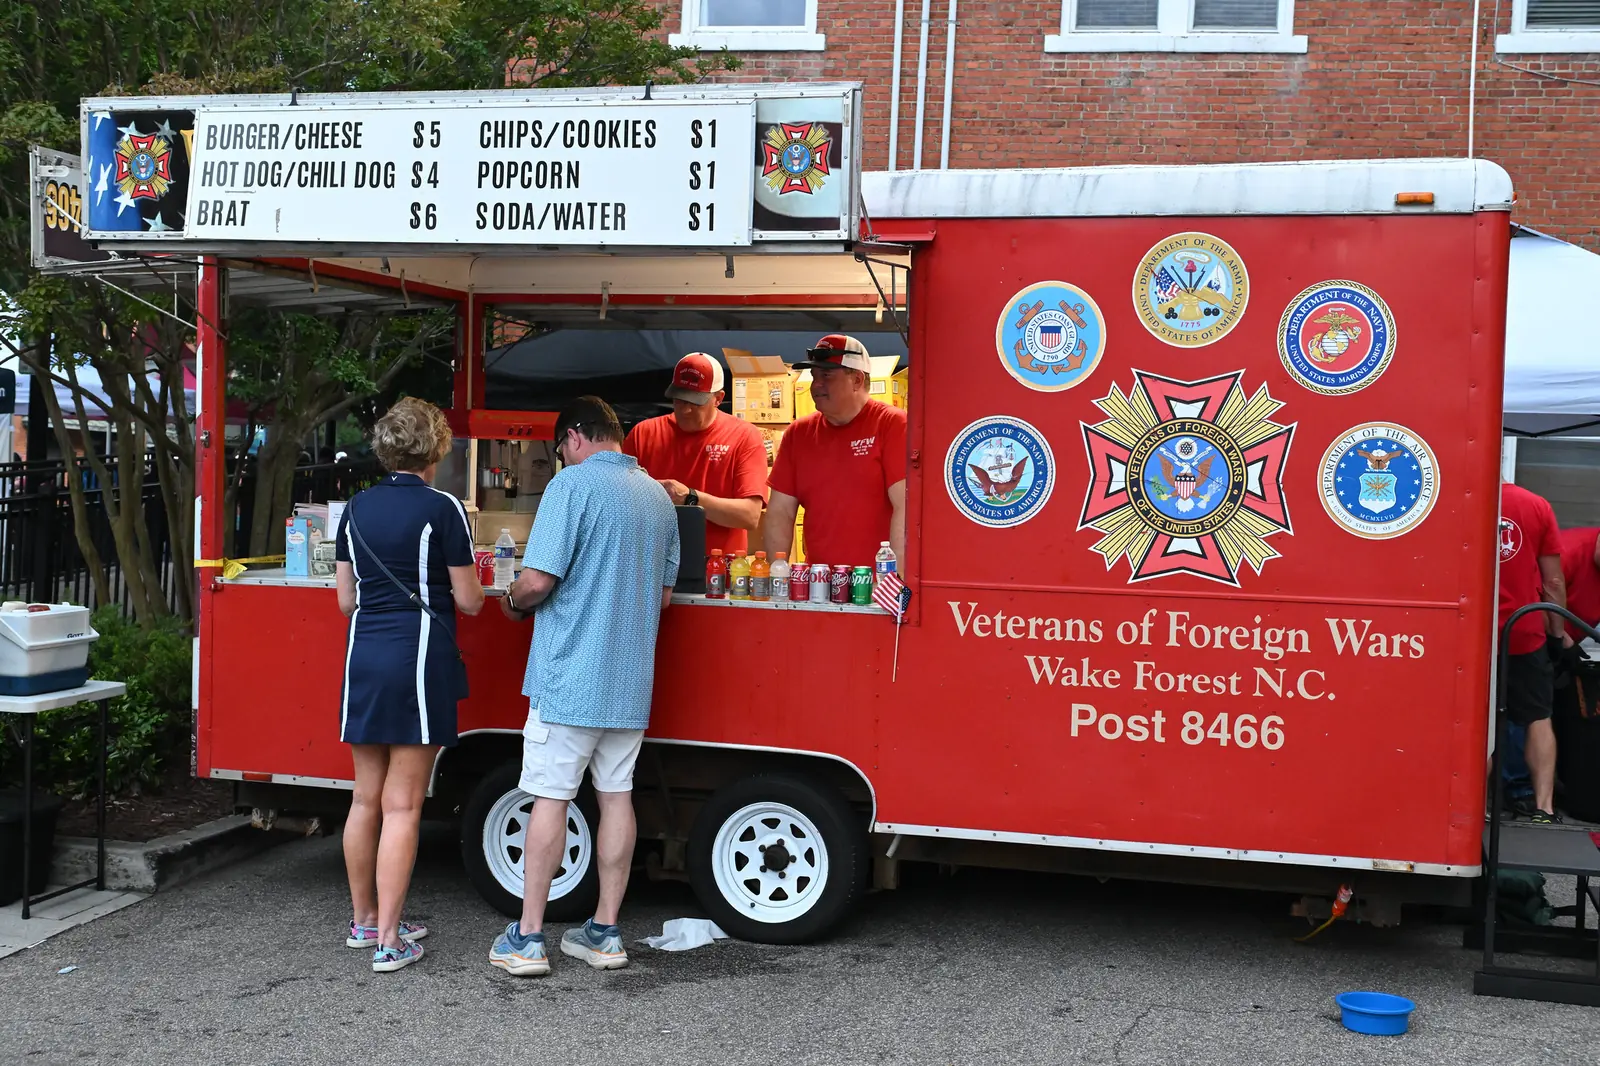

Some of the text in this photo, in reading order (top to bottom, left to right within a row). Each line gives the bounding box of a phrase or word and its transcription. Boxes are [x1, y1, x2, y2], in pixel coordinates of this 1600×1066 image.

[206, 121, 363, 150] BURGER/CHEESE
[413, 120, 441, 149] $5
[479, 118, 718, 149] CHIPS/COOKIES $1
[201, 160, 440, 189] HOT DOG/CHILI DOG $4
[477, 160, 716, 190] POPCORN $1
[197, 199, 437, 230] BRAT $6
[475, 202, 715, 231] SODA/WATER $1
[1140, 239, 1188, 285] DEPARTMENT
[1193, 238, 1206, 246] OF
[1210, 243, 1228, 258] THE
[1227, 259, 1244, 286] ARMY
[1139, 292, 1243, 341] UNITED STATES OF AMERICA
[1290, 290, 1384, 336] DEPARTMENT OF THE NAVY
[1027, 312, 1075, 355] UNITED STATES COAST GUARD
[1289, 342, 1383, 384] UNITED STATES MARINE CORPS
[956, 427, 1045, 467] DEPARTMENT OF THE NAVY
[1130, 422, 1243, 483] VETERANS OF FOREIGN WARS
[1324, 428, 1433, 503] DEPARTMENT OF THE AIR FORCE
[954, 475, 1044, 517] UNITED STATES OF AMERICA
[1136, 499, 1235, 534] OF THE UNITED STATES
[1333, 504, 1353, 524] UNITED
[1355, 522, 1377, 531] STATES
[1395, 508, 1421, 528] AMERICA
[1359, 512, 1395, 522] MCMXLVII
[710, 576, 718, 585] G
[736, 577, 744, 586] G
[947, 601, 1425, 661] Veterans of Foreign Wars
[1024, 655, 1336, 701] Wake Forest N.C.
[1070, 703, 1286, 751] Post 8466
